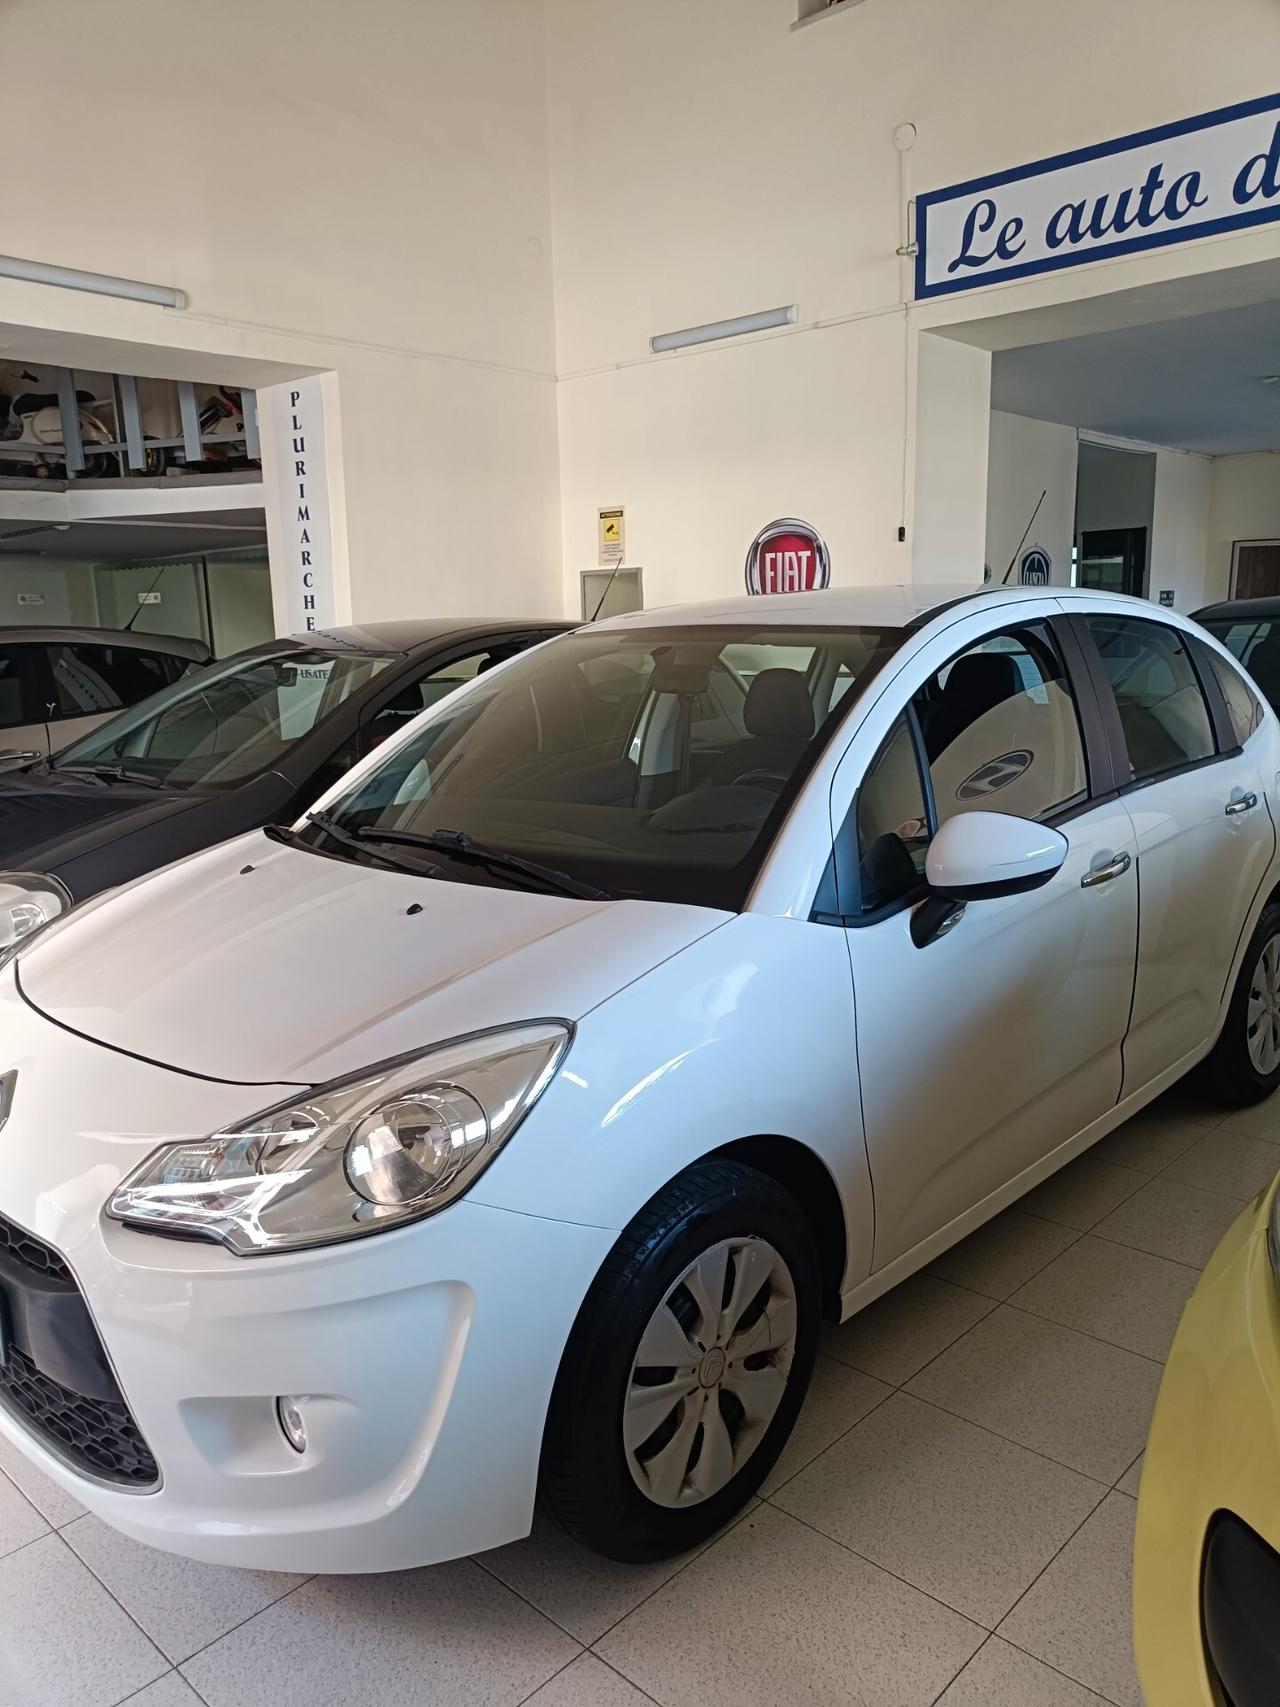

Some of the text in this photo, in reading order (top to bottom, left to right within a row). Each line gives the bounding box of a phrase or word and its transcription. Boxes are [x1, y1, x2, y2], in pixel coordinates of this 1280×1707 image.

[948, 199, 1026, 273] Le
[1045, 162, 1208, 249] auto
[290, 390, 315, 632] PLURIMARCHE
[765, 551, 811, 593] FIAT
